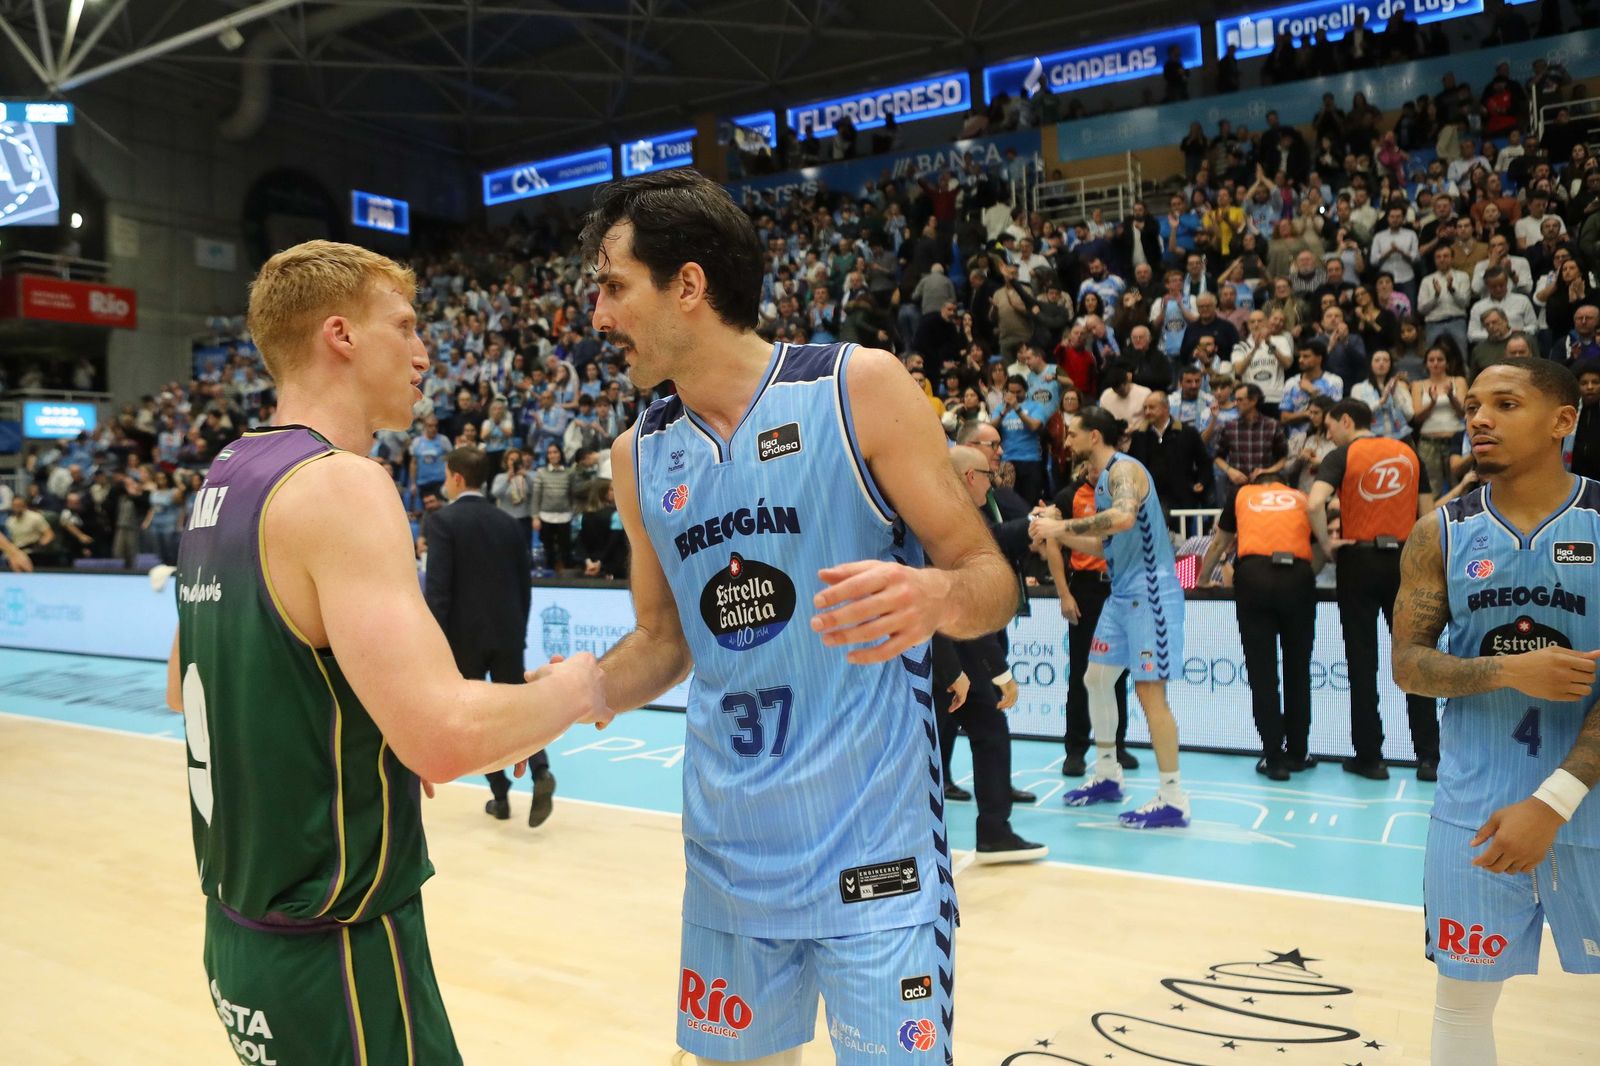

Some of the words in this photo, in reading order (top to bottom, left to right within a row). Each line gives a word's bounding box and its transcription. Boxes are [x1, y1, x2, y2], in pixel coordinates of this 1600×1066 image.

[1051, 46, 1157, 86] CANDELAS
[761, 438, 778, 449] liga
[762, 441, 798, 458] endesa
[1374, 467, 1401, 489] 72
[1557, 548, 1573, 556] liga
[1557, 554, 1592, 562] endesa
[716, 576, 776, 607] Estrella
[1467, 582, 1586, 617] BREOGÁN
[719, 600, 777, 629] Galicia
[720, 685, 794, 757] 37
[1512, 706, 1542, 758] 4
[1450, 953, 1461, 962] DE
[1464, 956, 1496, 965] GALICIA
[904, 985, 927, 999] acb
[687, 1017, 699, 1031] DE
[701, 1023, 739, 1039] GALICIA
